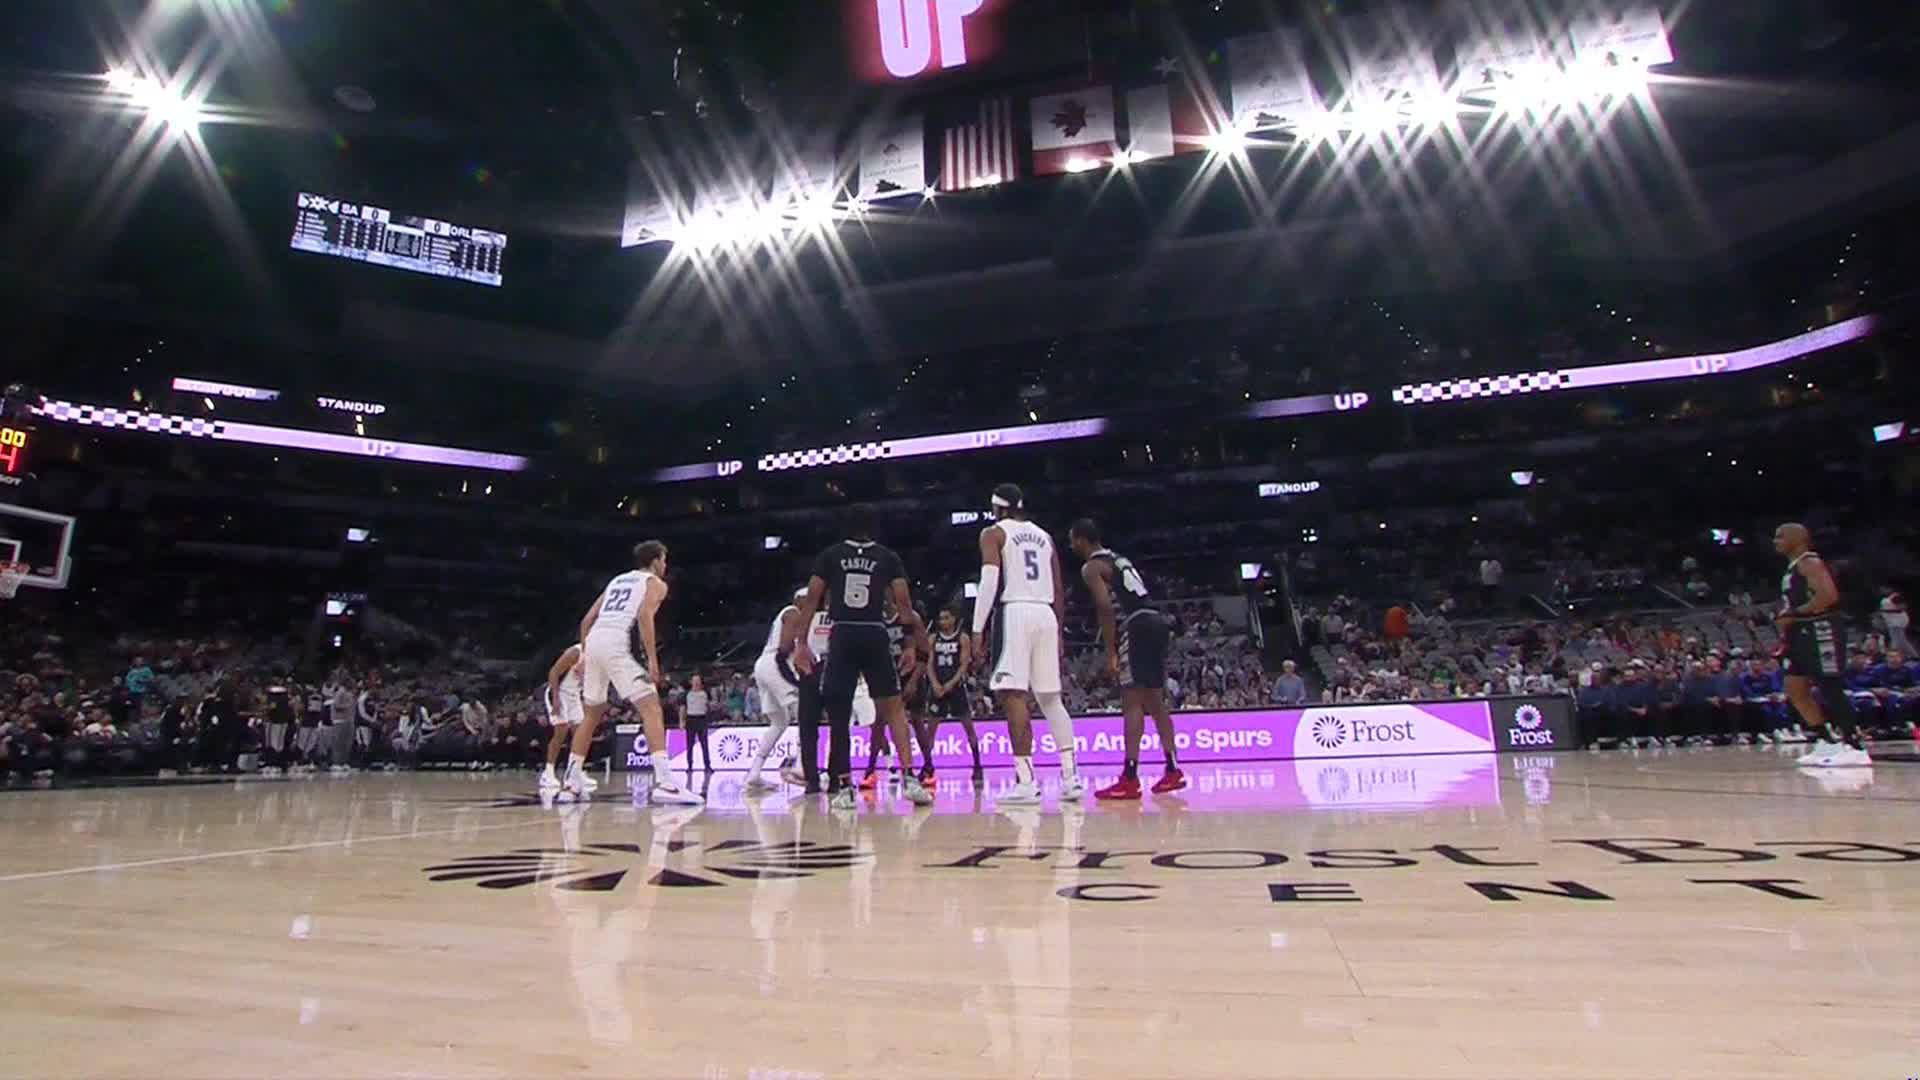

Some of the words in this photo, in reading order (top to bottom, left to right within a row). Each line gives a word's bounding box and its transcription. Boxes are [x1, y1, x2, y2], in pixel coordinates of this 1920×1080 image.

[876, 0, 984, 77] UP
[450, 225, 472, 239] ORL
[1691, 354, 1728, 374] UP
[317, 397, 385, 414] STANDUP
[1334, 393, 1369, 410] UP
[363, 436, 396, 456] UP
[970, 431, 1000, 448] UP
[717, 460, 742, 476] UP
[1259, 481, 1320, 497] STANDUP
[840, 557, 877, 573] CASTLE
[1022, 550, 1039, 580] 5
[603, 588, 632, 612] 22
[844, 573, 871, 608] 5
[1194, 728, 1273, 752] Spurs
[1351, 719, 1416, 743] Frost
[1509, 728, 1554, 745] Frost
[921, 845, 1540, 868] Frost
